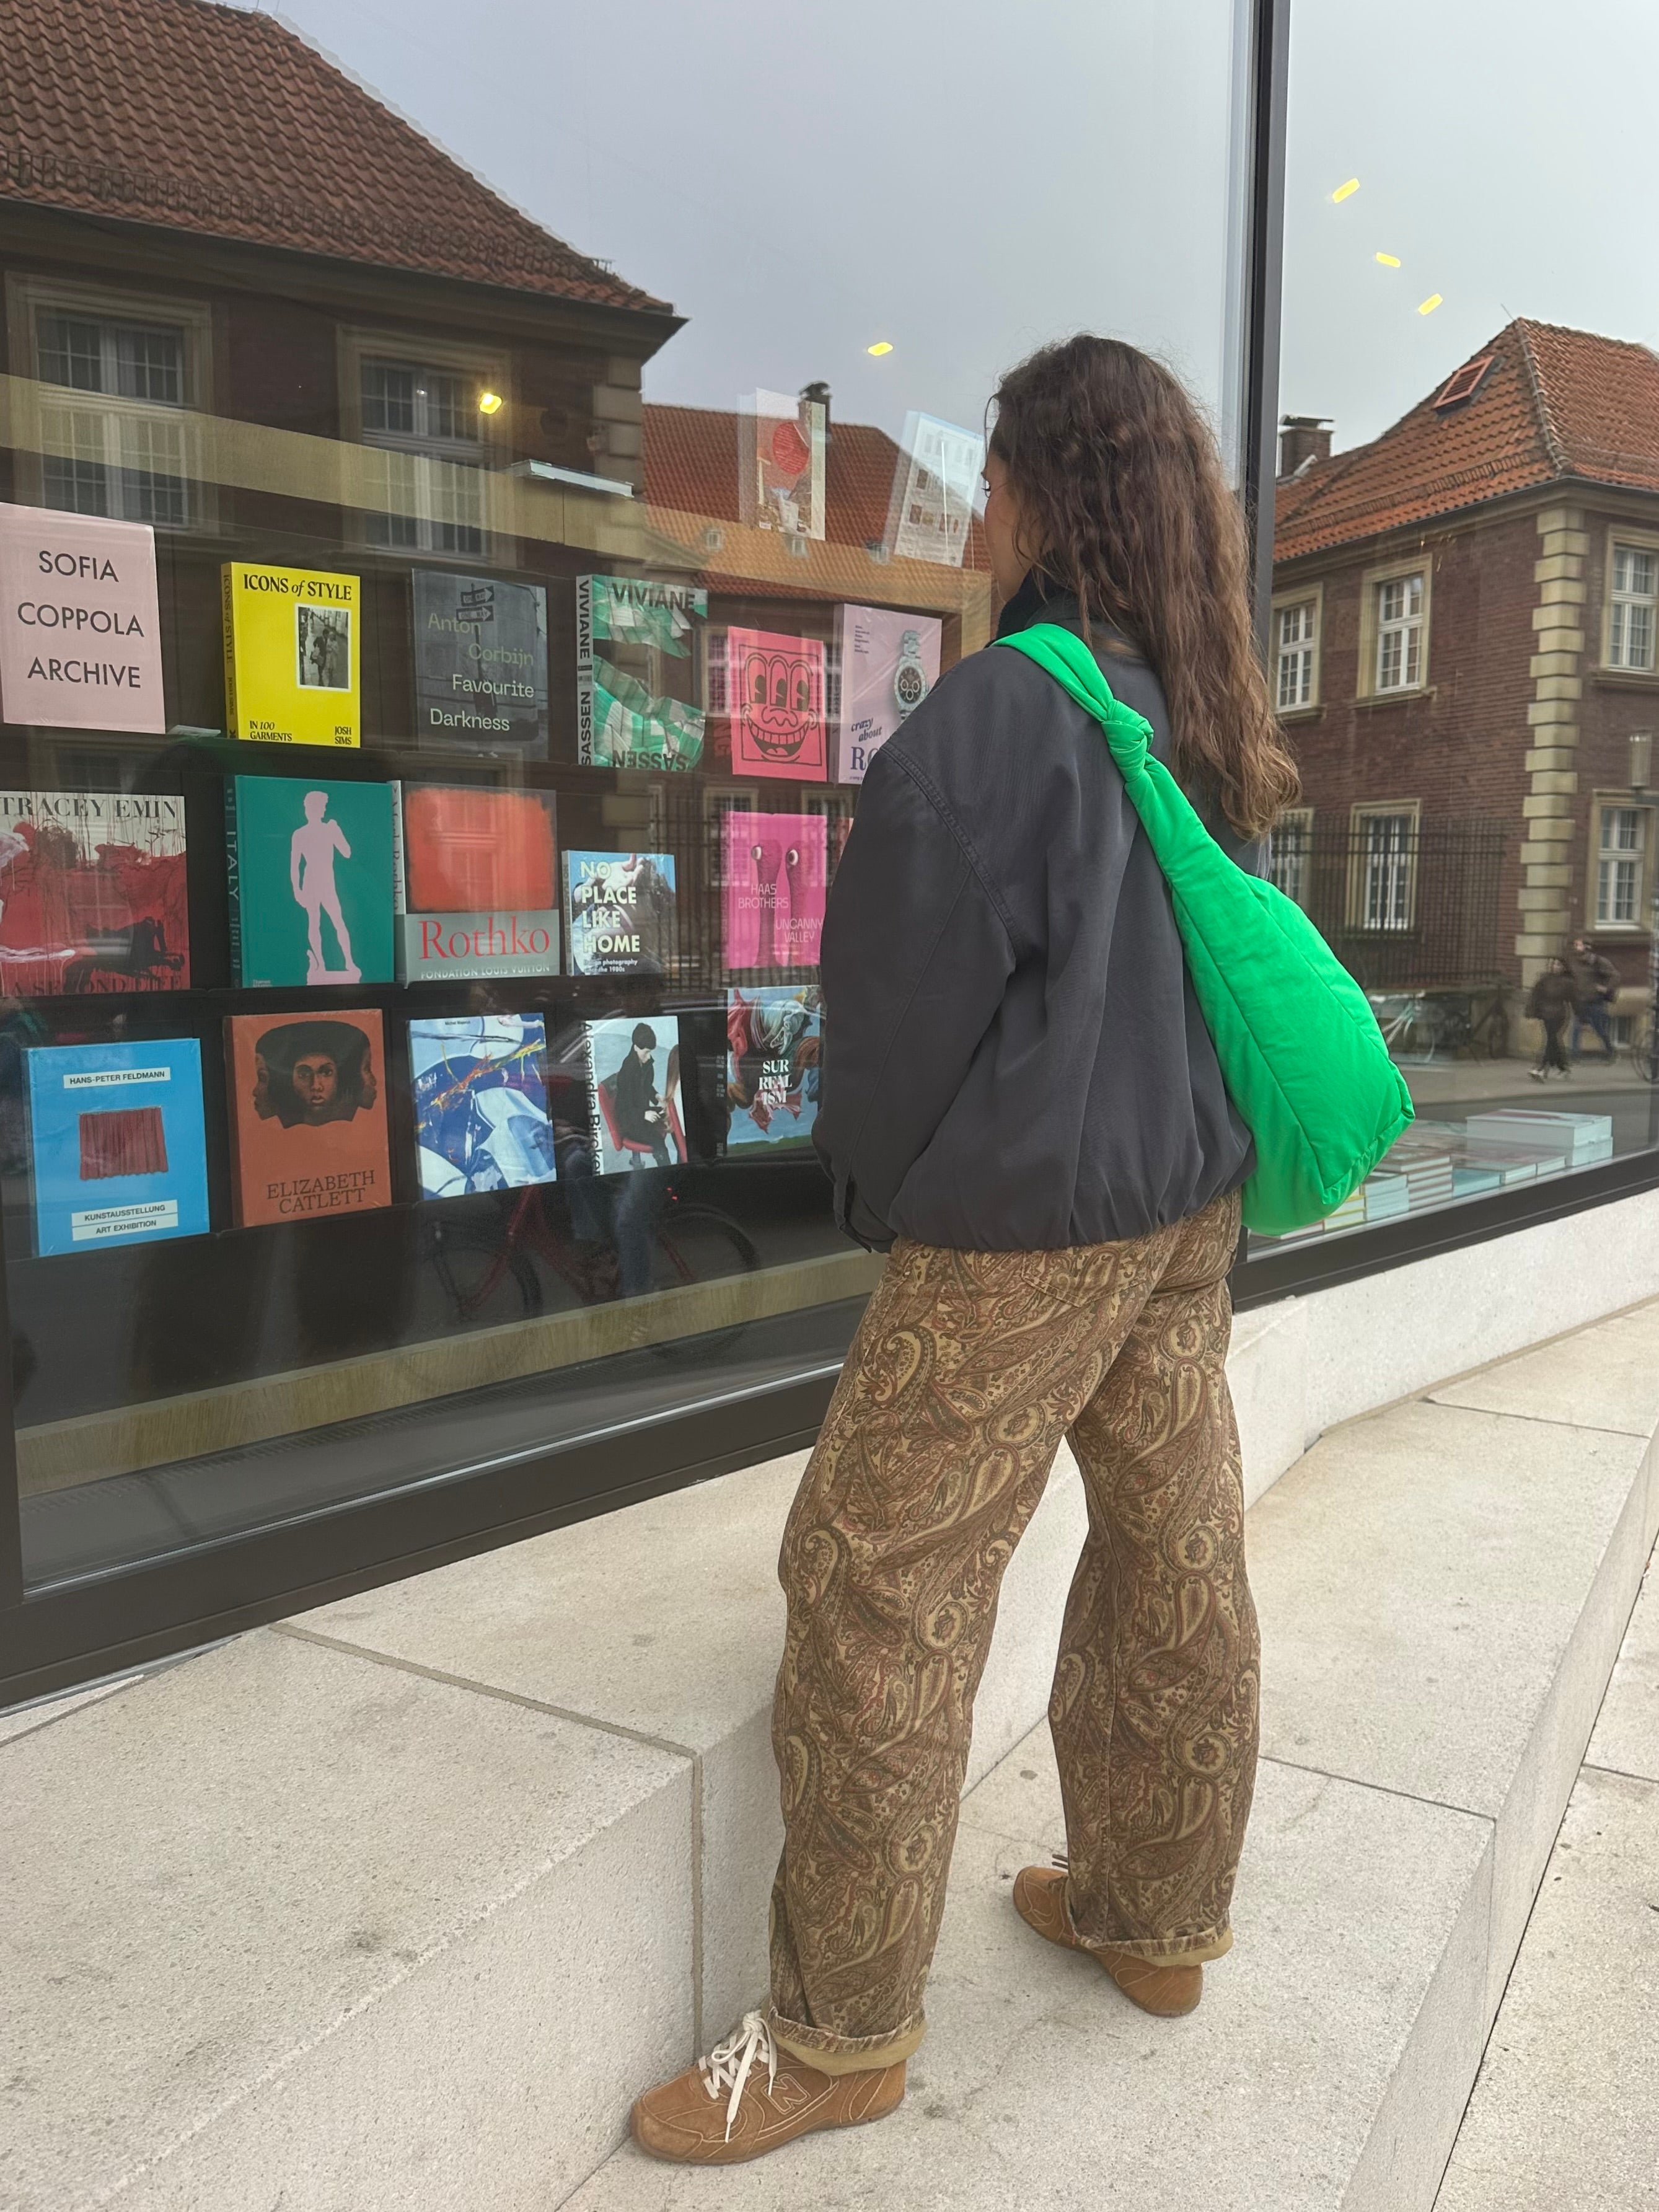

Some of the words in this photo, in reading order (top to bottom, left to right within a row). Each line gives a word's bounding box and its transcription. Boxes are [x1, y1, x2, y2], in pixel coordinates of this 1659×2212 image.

[39, 550, 119, 583] SOFIA
[244, 574, 289, 593] ICONS
[292, 580, 305, 597] of
[307, 581, 352, 601] STYLE
[612, 583, 695, 610] VIVIANE
[18, 602, 145, 637] COPPOLA
[428, 612, 481, 635] Anton
[578, 579, 591, 659] VIVIANE
[469, 643, 534, 669] Corbijn
[27, 656, 141, 689] ARCHIVE
[452, 674, 534, 698] Favourite
[250, 720, 258, 729] IN
[260, 721, 275, 730] 100
[430, 708, 511, 731] Darkness
[581, 691, 591, 765] SASSEN
[851, 718, 873, 732] crazy
[250, 731, 292, 742] GARMENTS
[335, 726, 351, 736] JOSH
[858, 726, 882, 742] about
[335, 736, 351, 745] SIMS
[612, 749, 687, 771] SASSEN
[0, 796, 107, 817] TRACEY
[116, 800, 177, 819] EMIN
[227, 831, 239, 900] ITALY
[580, 860, 611, 879] NO
[581, 885, 637, 904] PLACE
[750, 883, 777, 895] HAAS
[738, 897, 789, 909] BROTHERS
[582, 910, 620, 928] LIKE
[775, 918, 824, 930] UNCANNY
[417, 915, 550, 959] Rothko
[583, 935, 640, 953] HOME
[785, 932, 815, 943] VALLEY
[421, 967, 478, 979] FONDATION
[482, 966, 508, 976] LOUIS
[511, 963, 550, 974] VUITTON
[602, 958, 638, 967] photography
[762, 1059, 790, 1074] SUR
[69, 1073, 121, 1085] HANS-PETER
[123, 1070, 165, 1082] FELDMANN
[759, 1074, 793, 1090] REAL
[762, 1090, 787, 1105] ISM
[266, 1170, 376, 1199] ELIZABETH
[279, 1188, 366, 1214] CATLETT
[84, 1204, 165, 1222] KUNSTAUSSTELLUNG
[95, 1226, 111, 1234] ART
[114, 1219, 157, 1232] EXHIBITION
